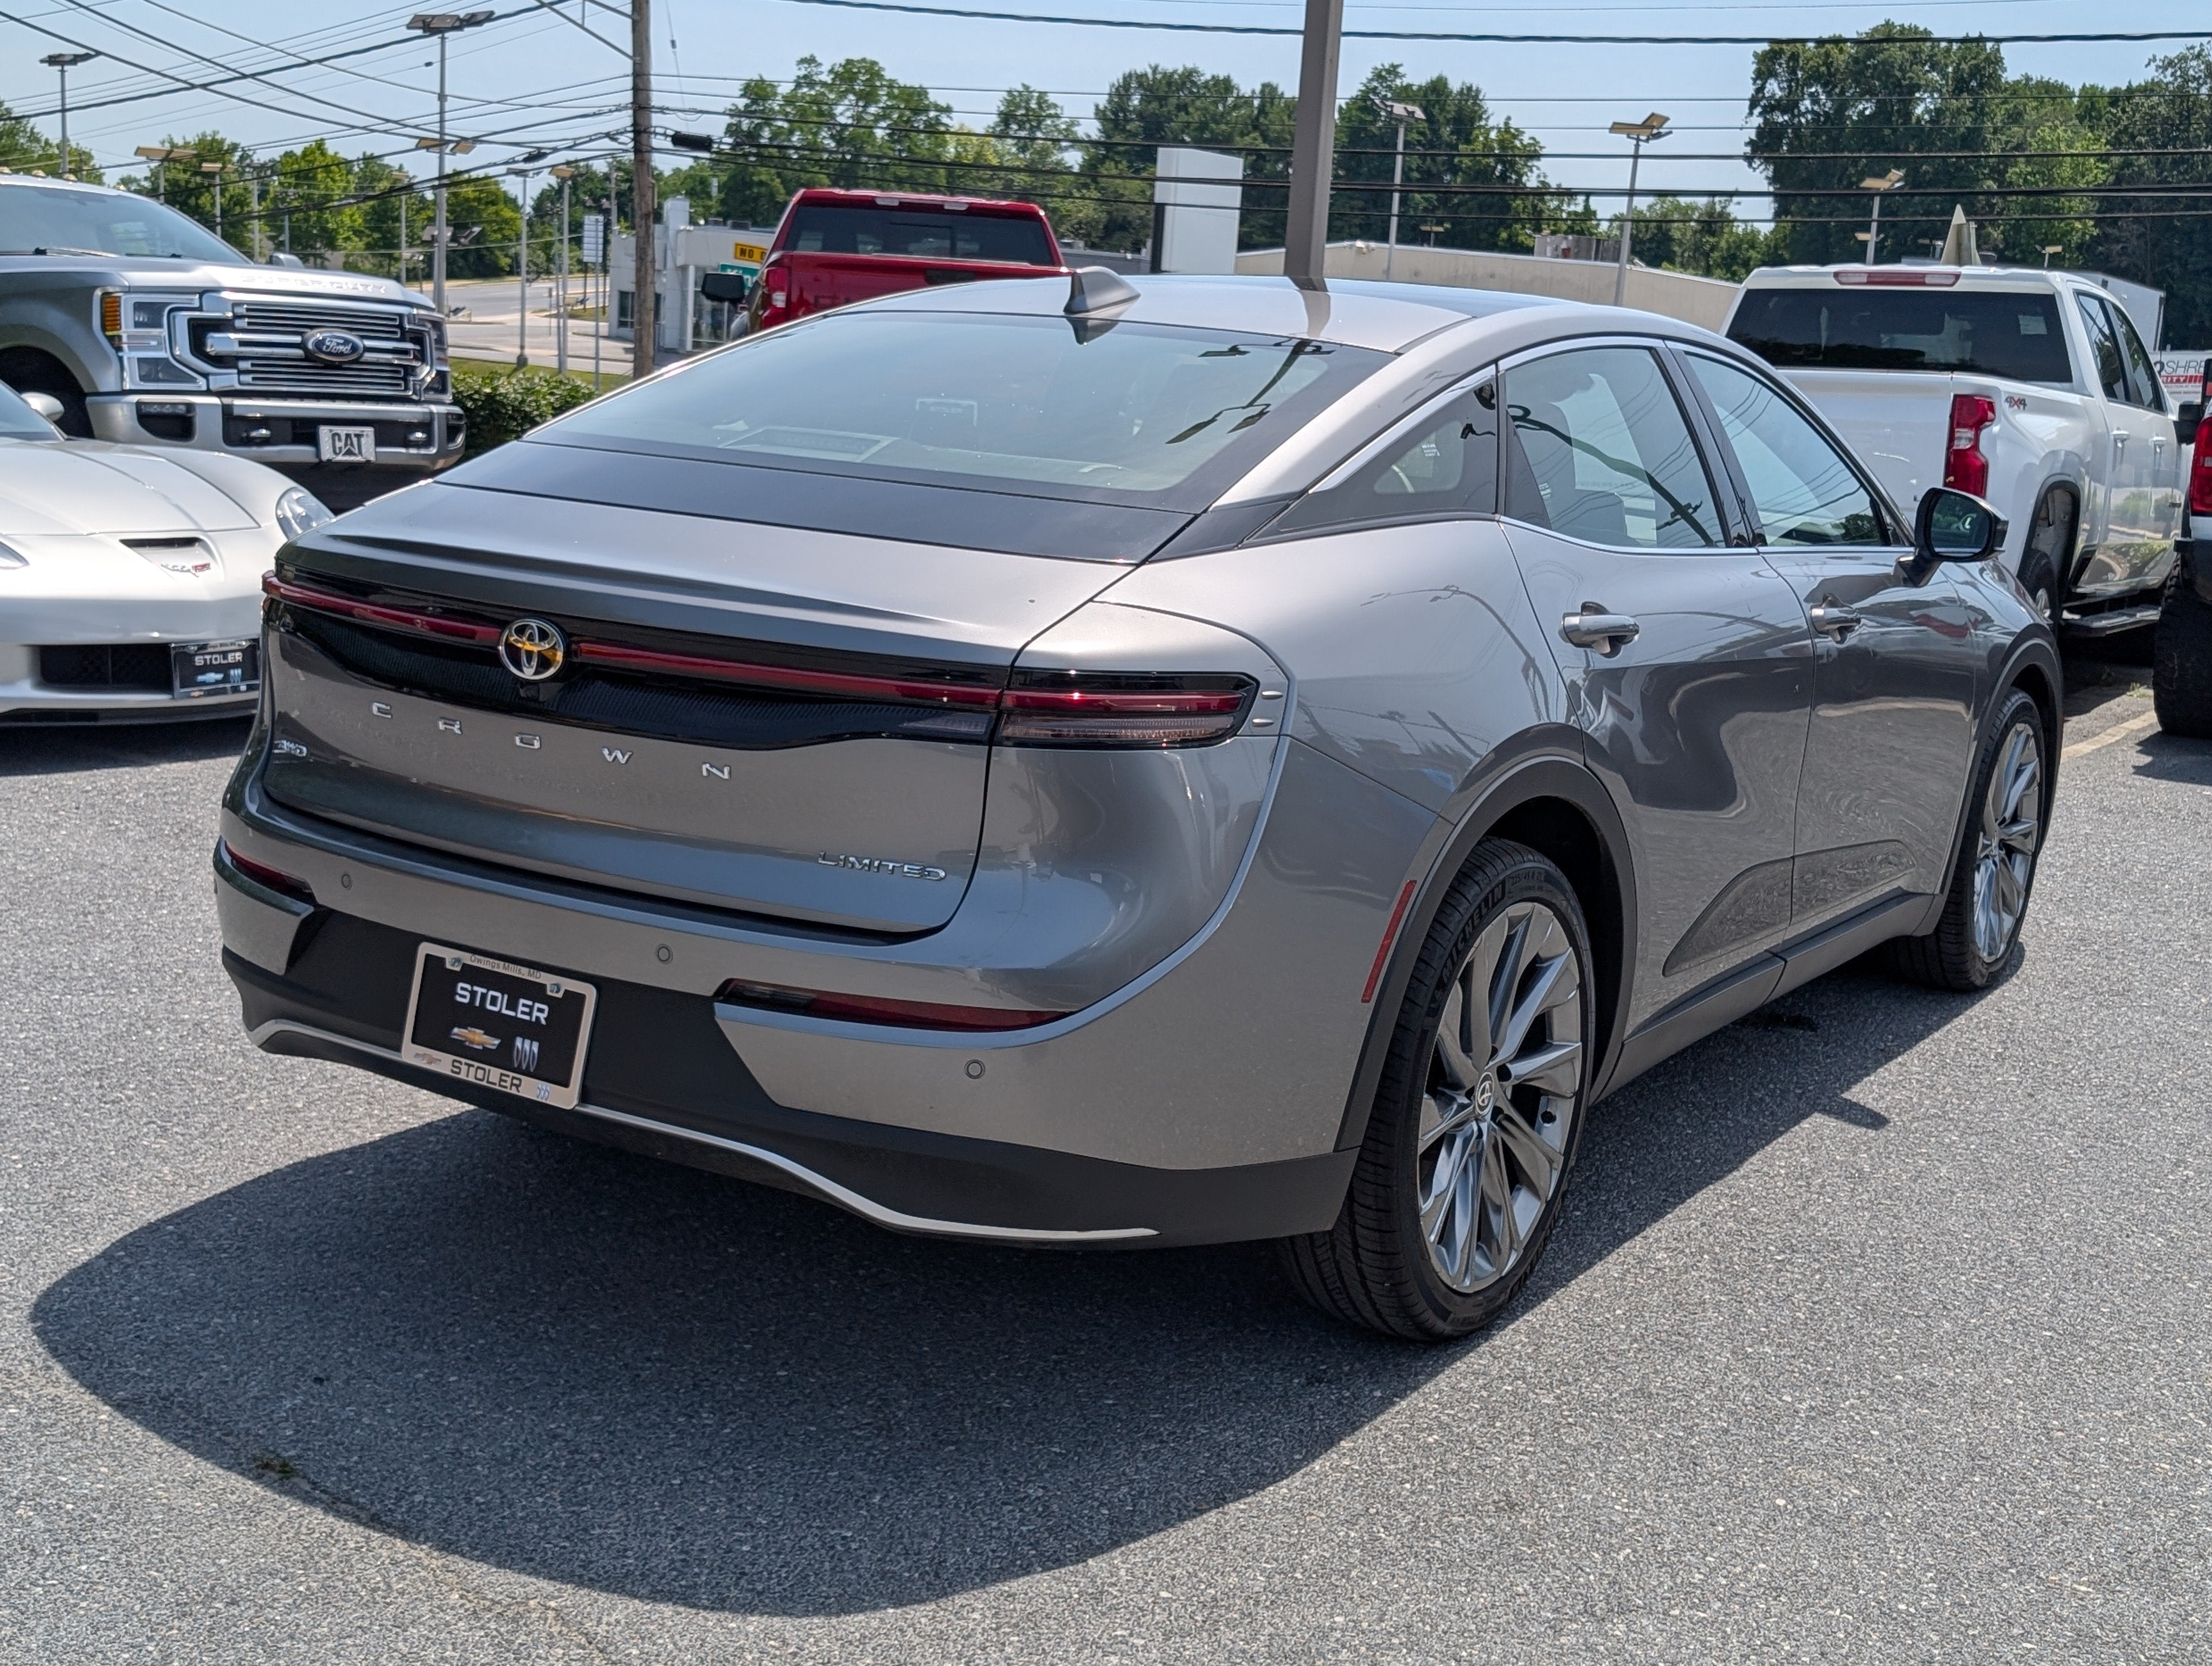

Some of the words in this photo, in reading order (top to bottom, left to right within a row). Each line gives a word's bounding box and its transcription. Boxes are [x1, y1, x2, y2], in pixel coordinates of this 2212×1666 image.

[740, 247, 754, 259] NO
[323, 336, 353, 354] Ford
[331, 432, 364, 457] CAT
[195, 651, 243, 666] STOLER
[372, 702, 731, 780] CROWN
[818, 850, 947, 881] LIMITED
[1442, 882, 1503, 984] MICHELIN
[470, 954, 500, 970] Owings
[503, 963, 525, 976] Mills,
[528, 969, 542, 979] MD
[455, 982, 549, 1026] STOLER
[451, 1059, 523, 1093] STOLER
